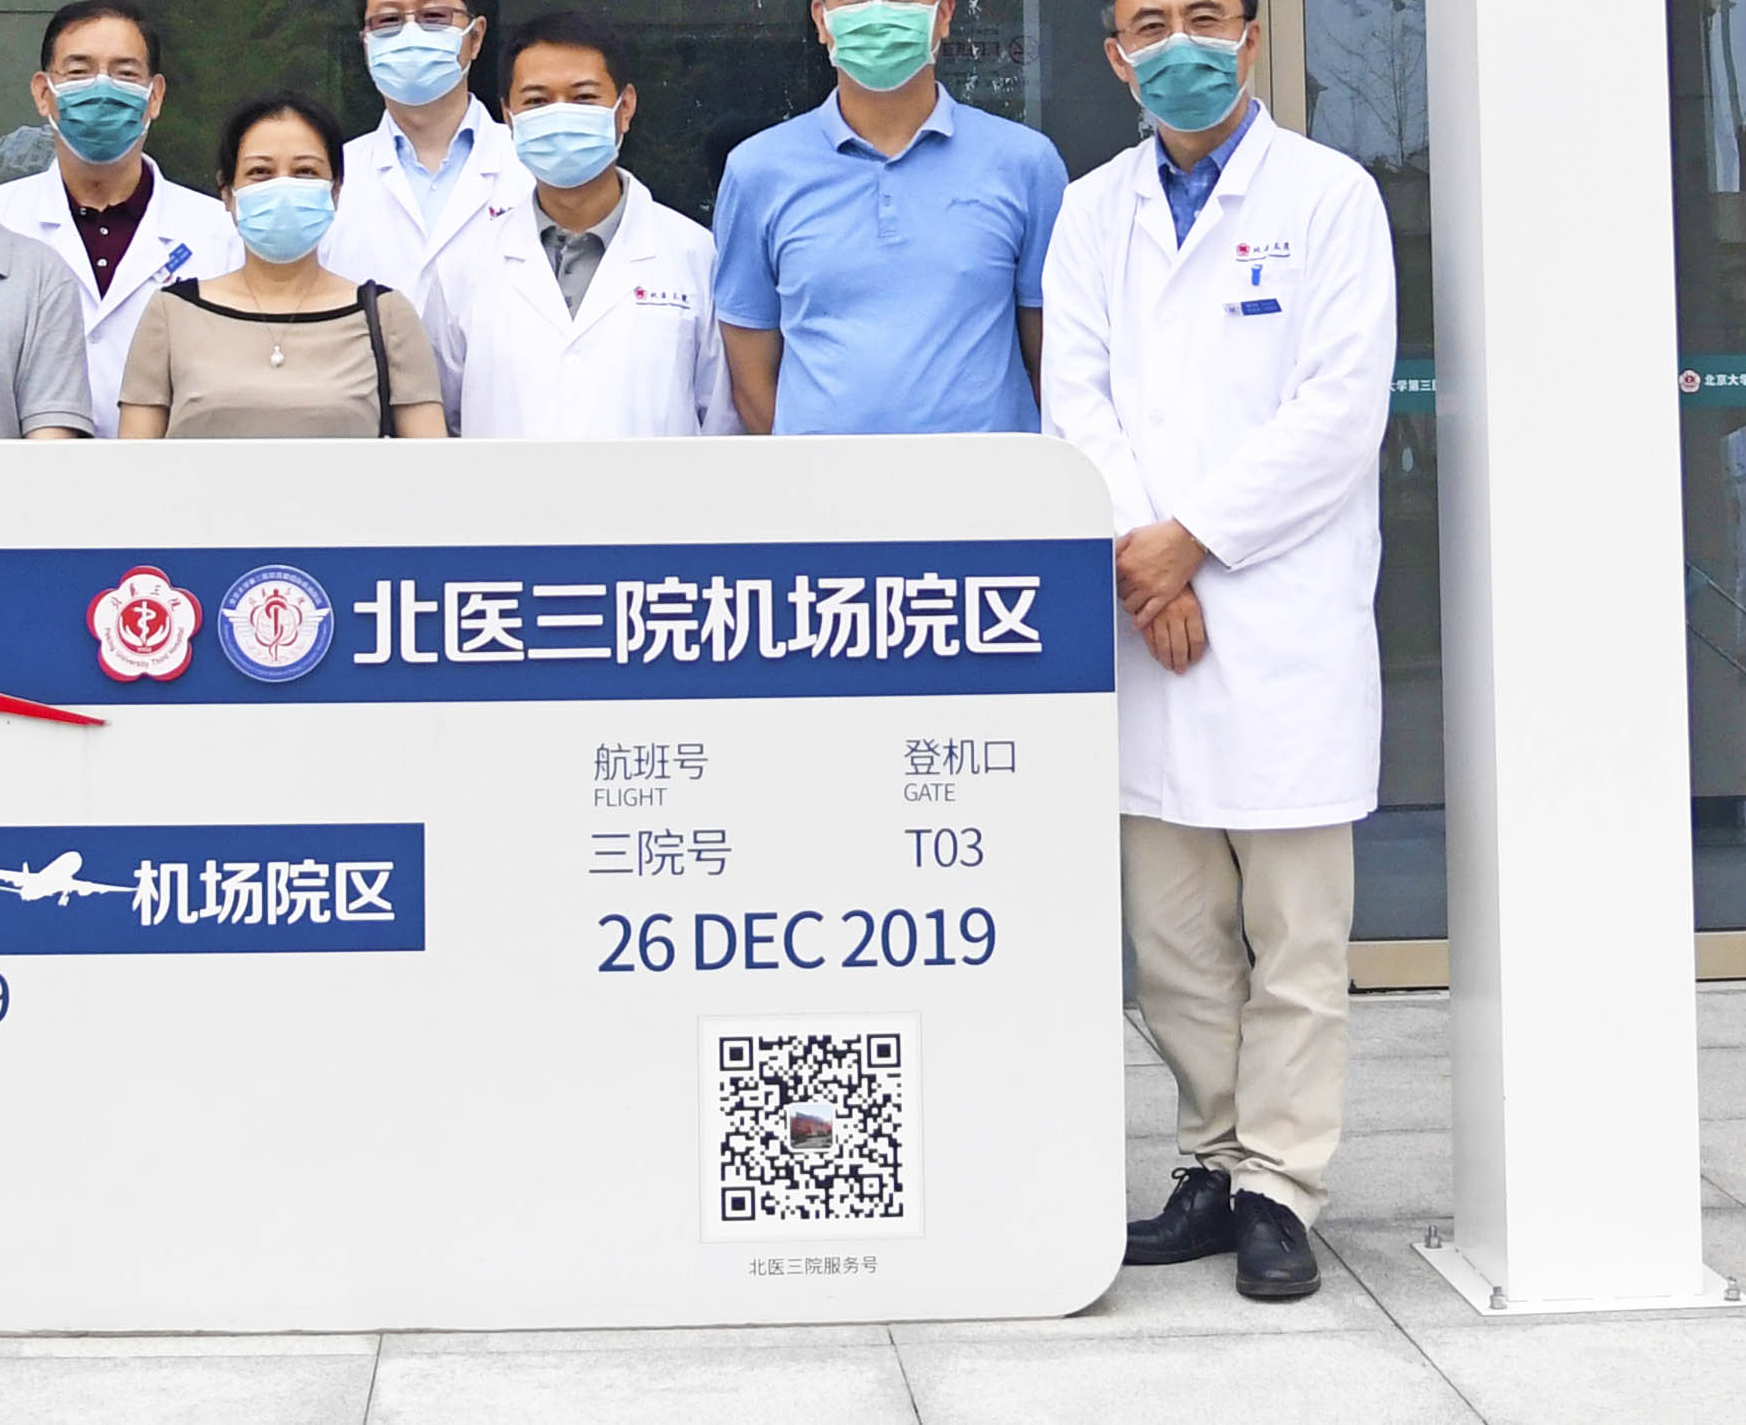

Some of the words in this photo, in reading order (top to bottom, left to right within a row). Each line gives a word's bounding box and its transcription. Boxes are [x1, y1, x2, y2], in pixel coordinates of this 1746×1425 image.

[354, 573, 1042, 663] 北医三院机场院区
[595, 743, 708, 780] 航班号
[905, 739, 1015, 775] 登机口
[595, 788, 667, 807] FLIGHT
[904, 783, 955, 801] GATE
[589, 829, 731, 876] 三院号
[905, 828, 983, 867] T03
[132, 859, 395, 926] 机场院区
[599, 914, 675, 972] 26
[695, 911, 825, 970] DEC
[842, 907, 995, 967] 2019
[749, 1255, 878, 1276] 北医三院服务号
